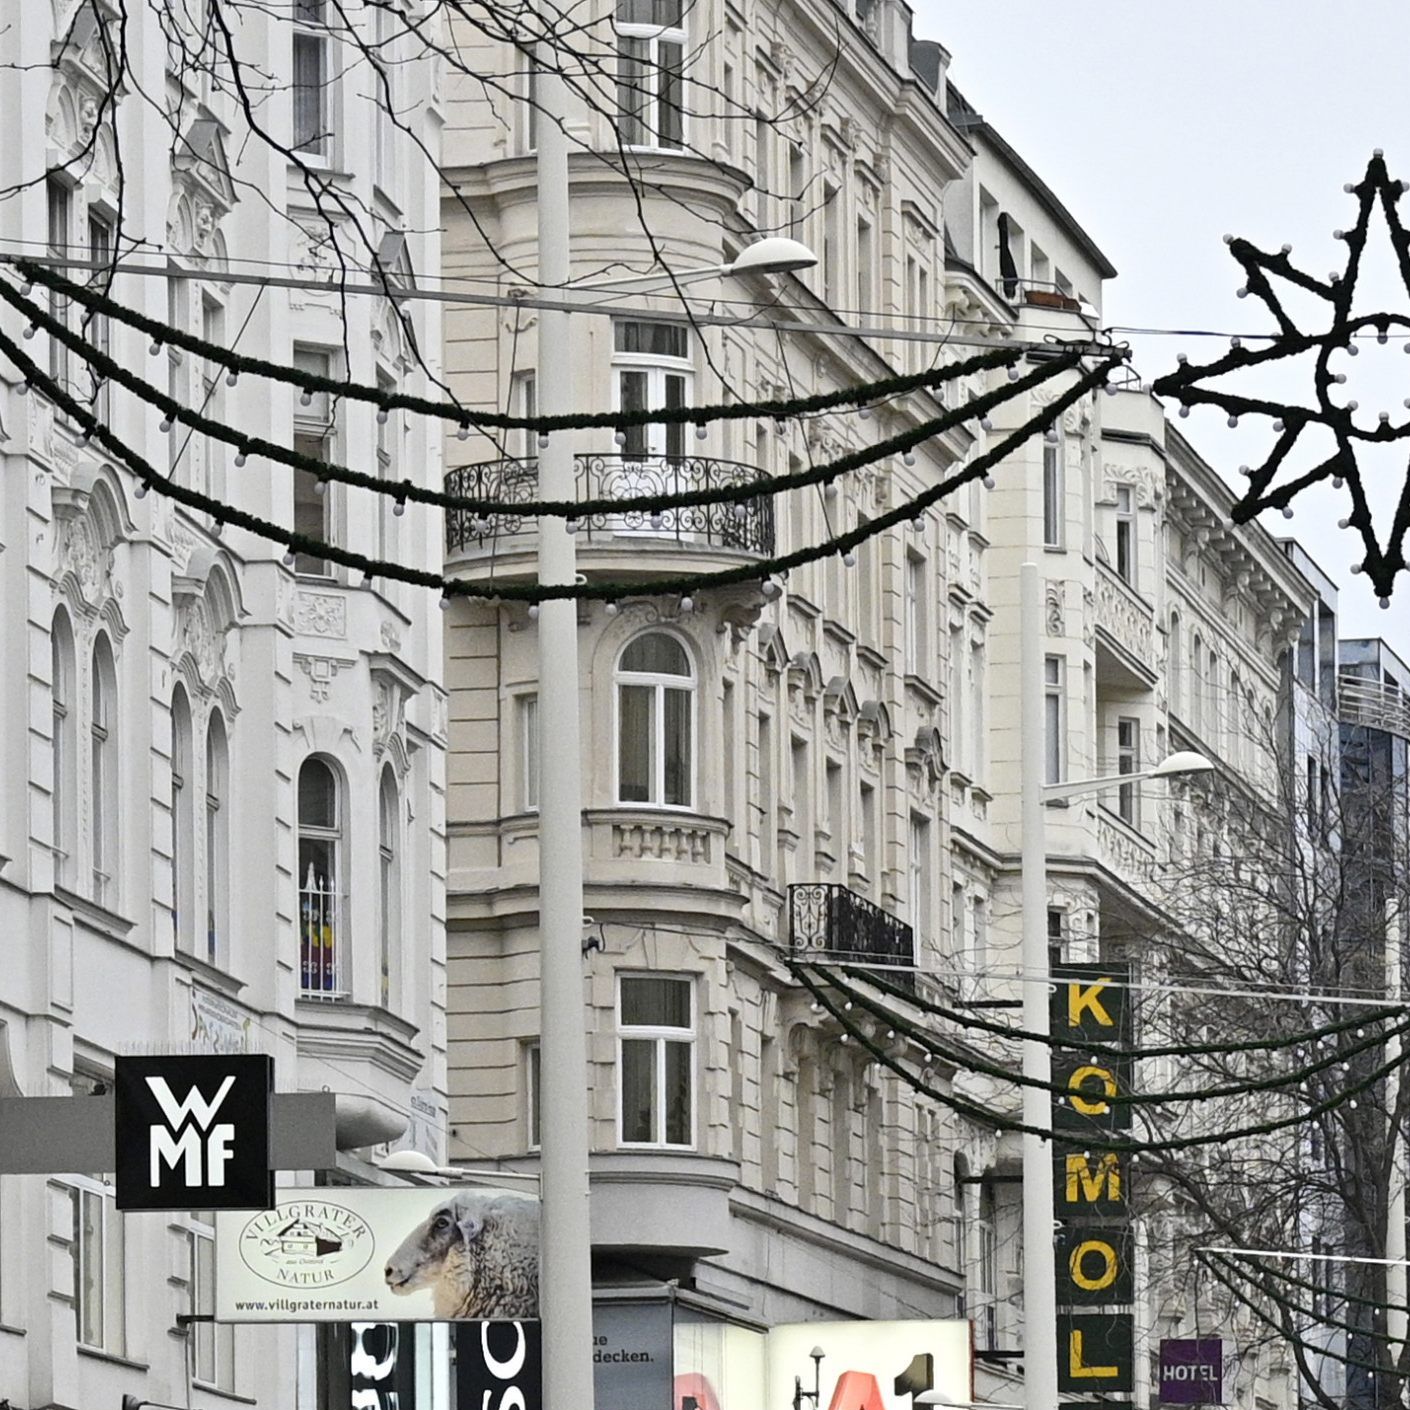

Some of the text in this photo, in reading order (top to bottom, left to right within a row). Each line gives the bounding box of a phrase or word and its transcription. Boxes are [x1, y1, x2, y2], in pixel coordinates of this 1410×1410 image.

[145, 1076, 236, 1187] WMF
[246, 1204, 366, 1241] VILLGRATER
[277, 1268, 335, 1284] NATUR
[235, 1299, 379, 1313] www.villgraternatur.at
[1163, 1365, 1218, 1381] HOTEL
